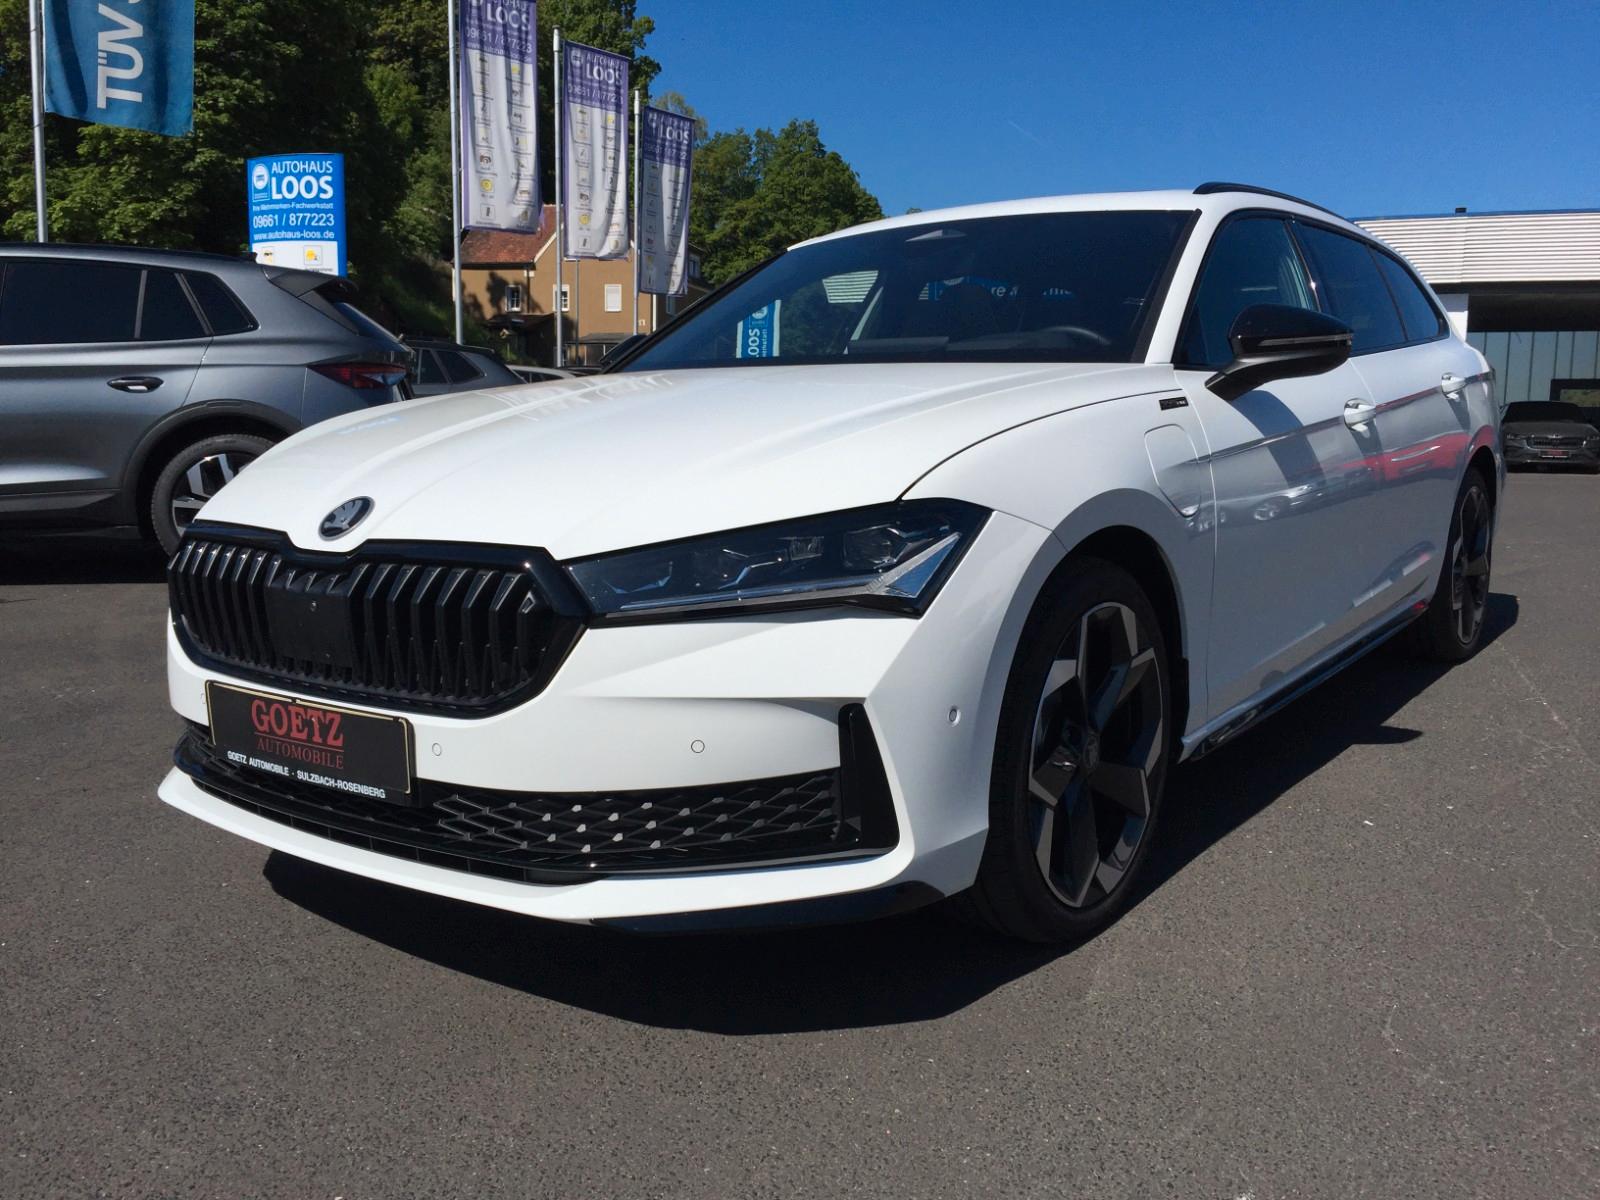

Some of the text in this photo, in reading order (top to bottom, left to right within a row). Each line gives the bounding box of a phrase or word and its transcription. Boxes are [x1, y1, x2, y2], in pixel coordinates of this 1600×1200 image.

[486, 3, 528, 31] LOOS
[97, 3, 144, 109] TÜV
[586, 63, 623, 86] LOOS
[271, 161, 334, 174] AUTOHAUS
[271, 175, 334, 200] LOOS
[253, 214, 279, 229] 09661
[289, 213, 335, 227] 877223
[747, 328, 761, 358] OOS
[251, 699, 344, 747] GOETZ
[256, 735, 344, 770] AUTOMOBILE
[227, 750, 248, 765] GOETZ
[248, 757, 290, 776] AUTOMOBILE
[296, 769, 386, 799] SULZBACH-ROSENBERG
